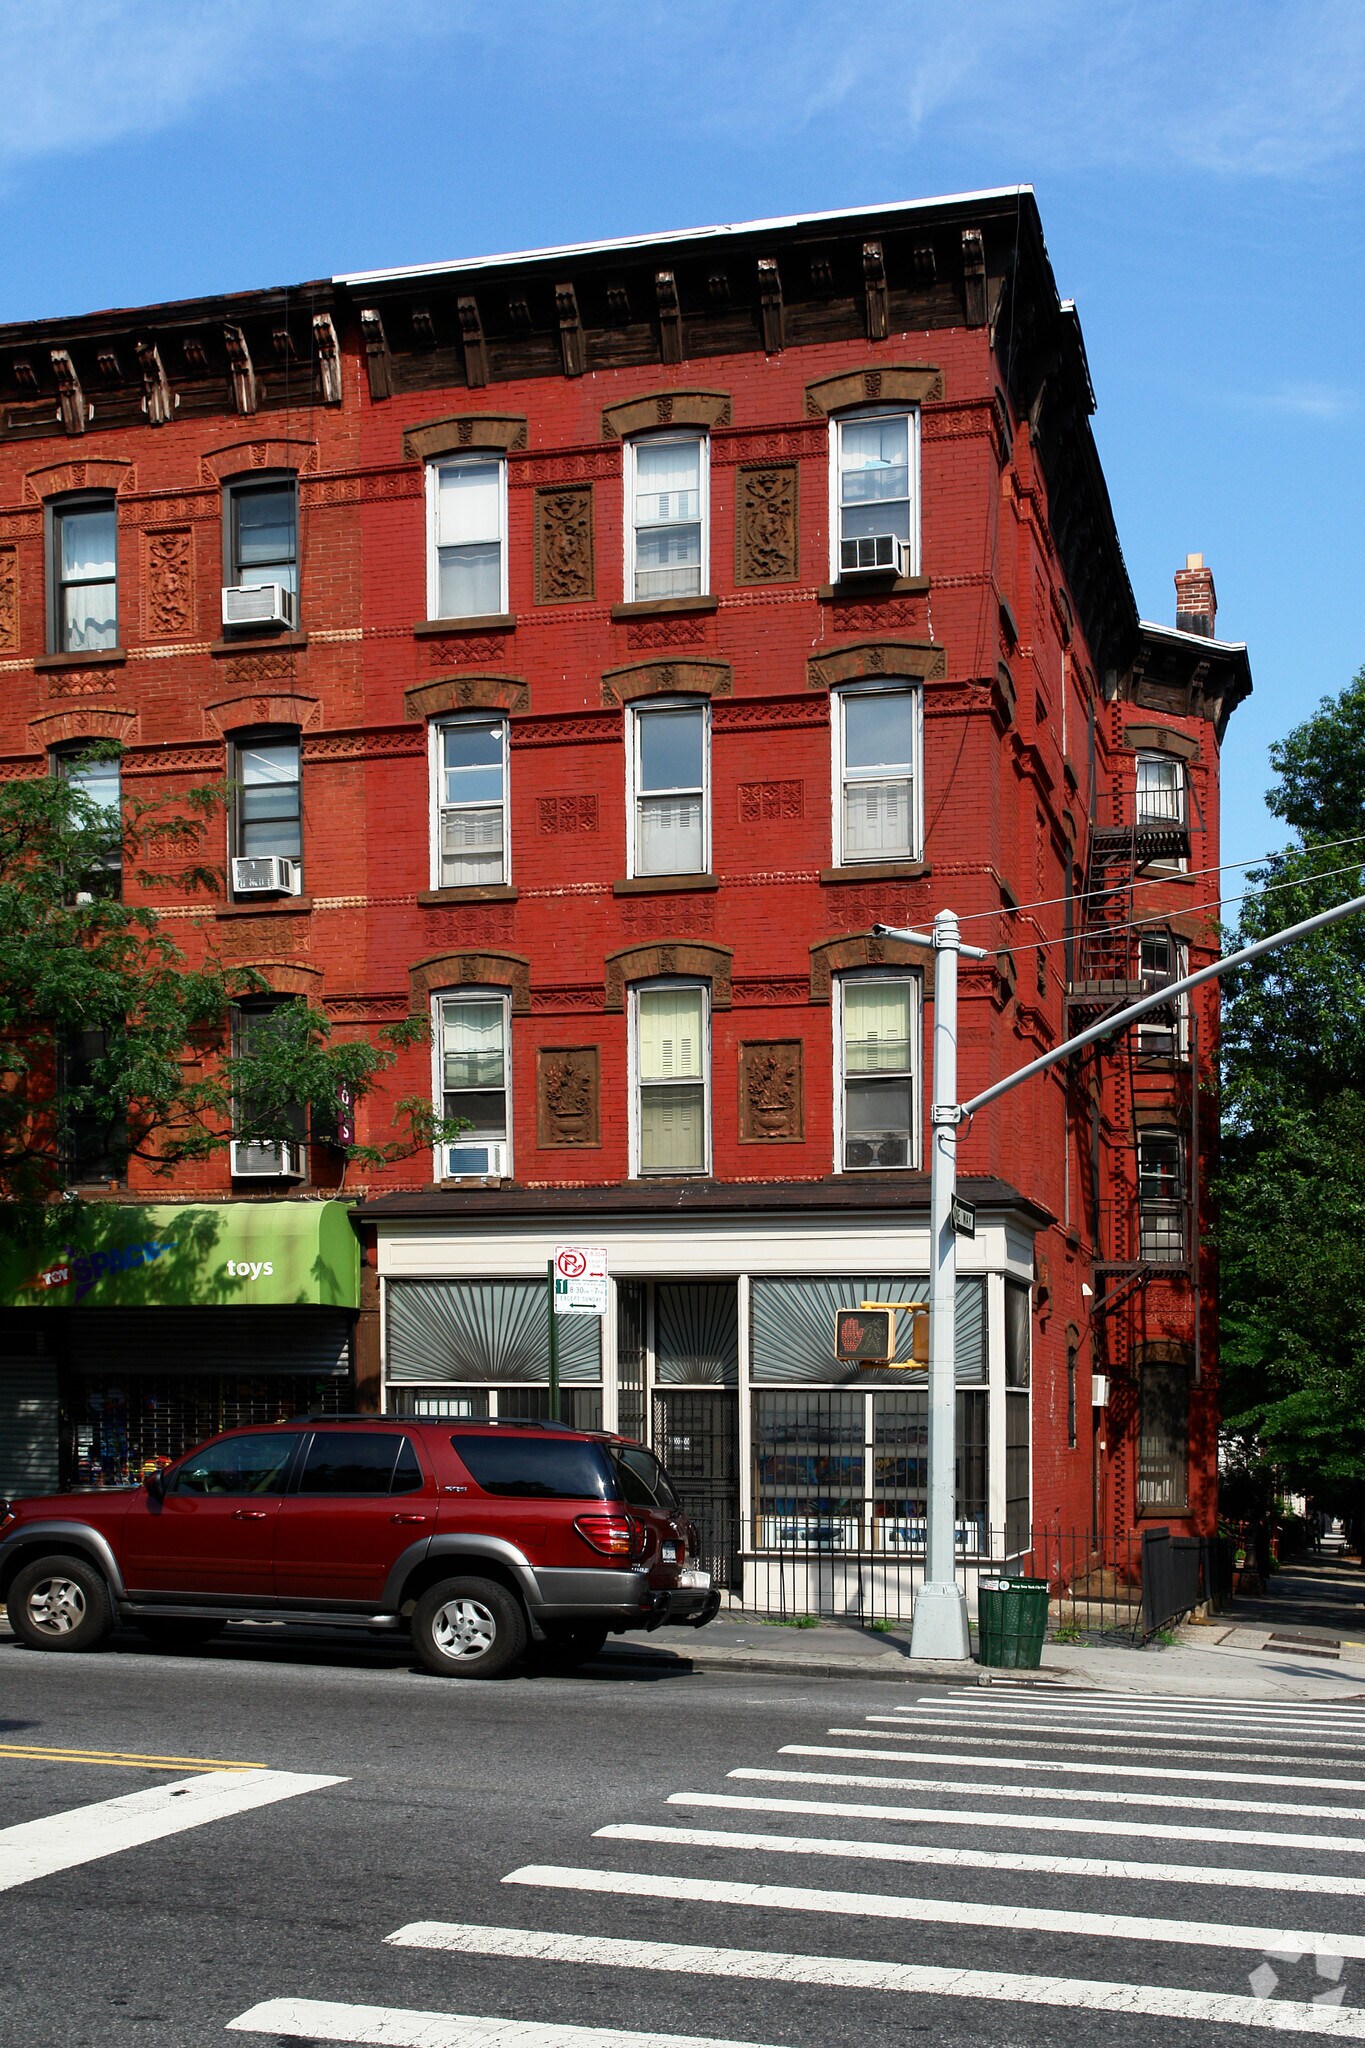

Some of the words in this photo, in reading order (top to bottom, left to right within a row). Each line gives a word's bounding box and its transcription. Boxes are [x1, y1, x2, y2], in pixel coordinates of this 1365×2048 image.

[963, 1211, 973, 1229] WAY
[42, 1267, 69, 1285] TOY
[226, 1259, 274, 1281] toys
